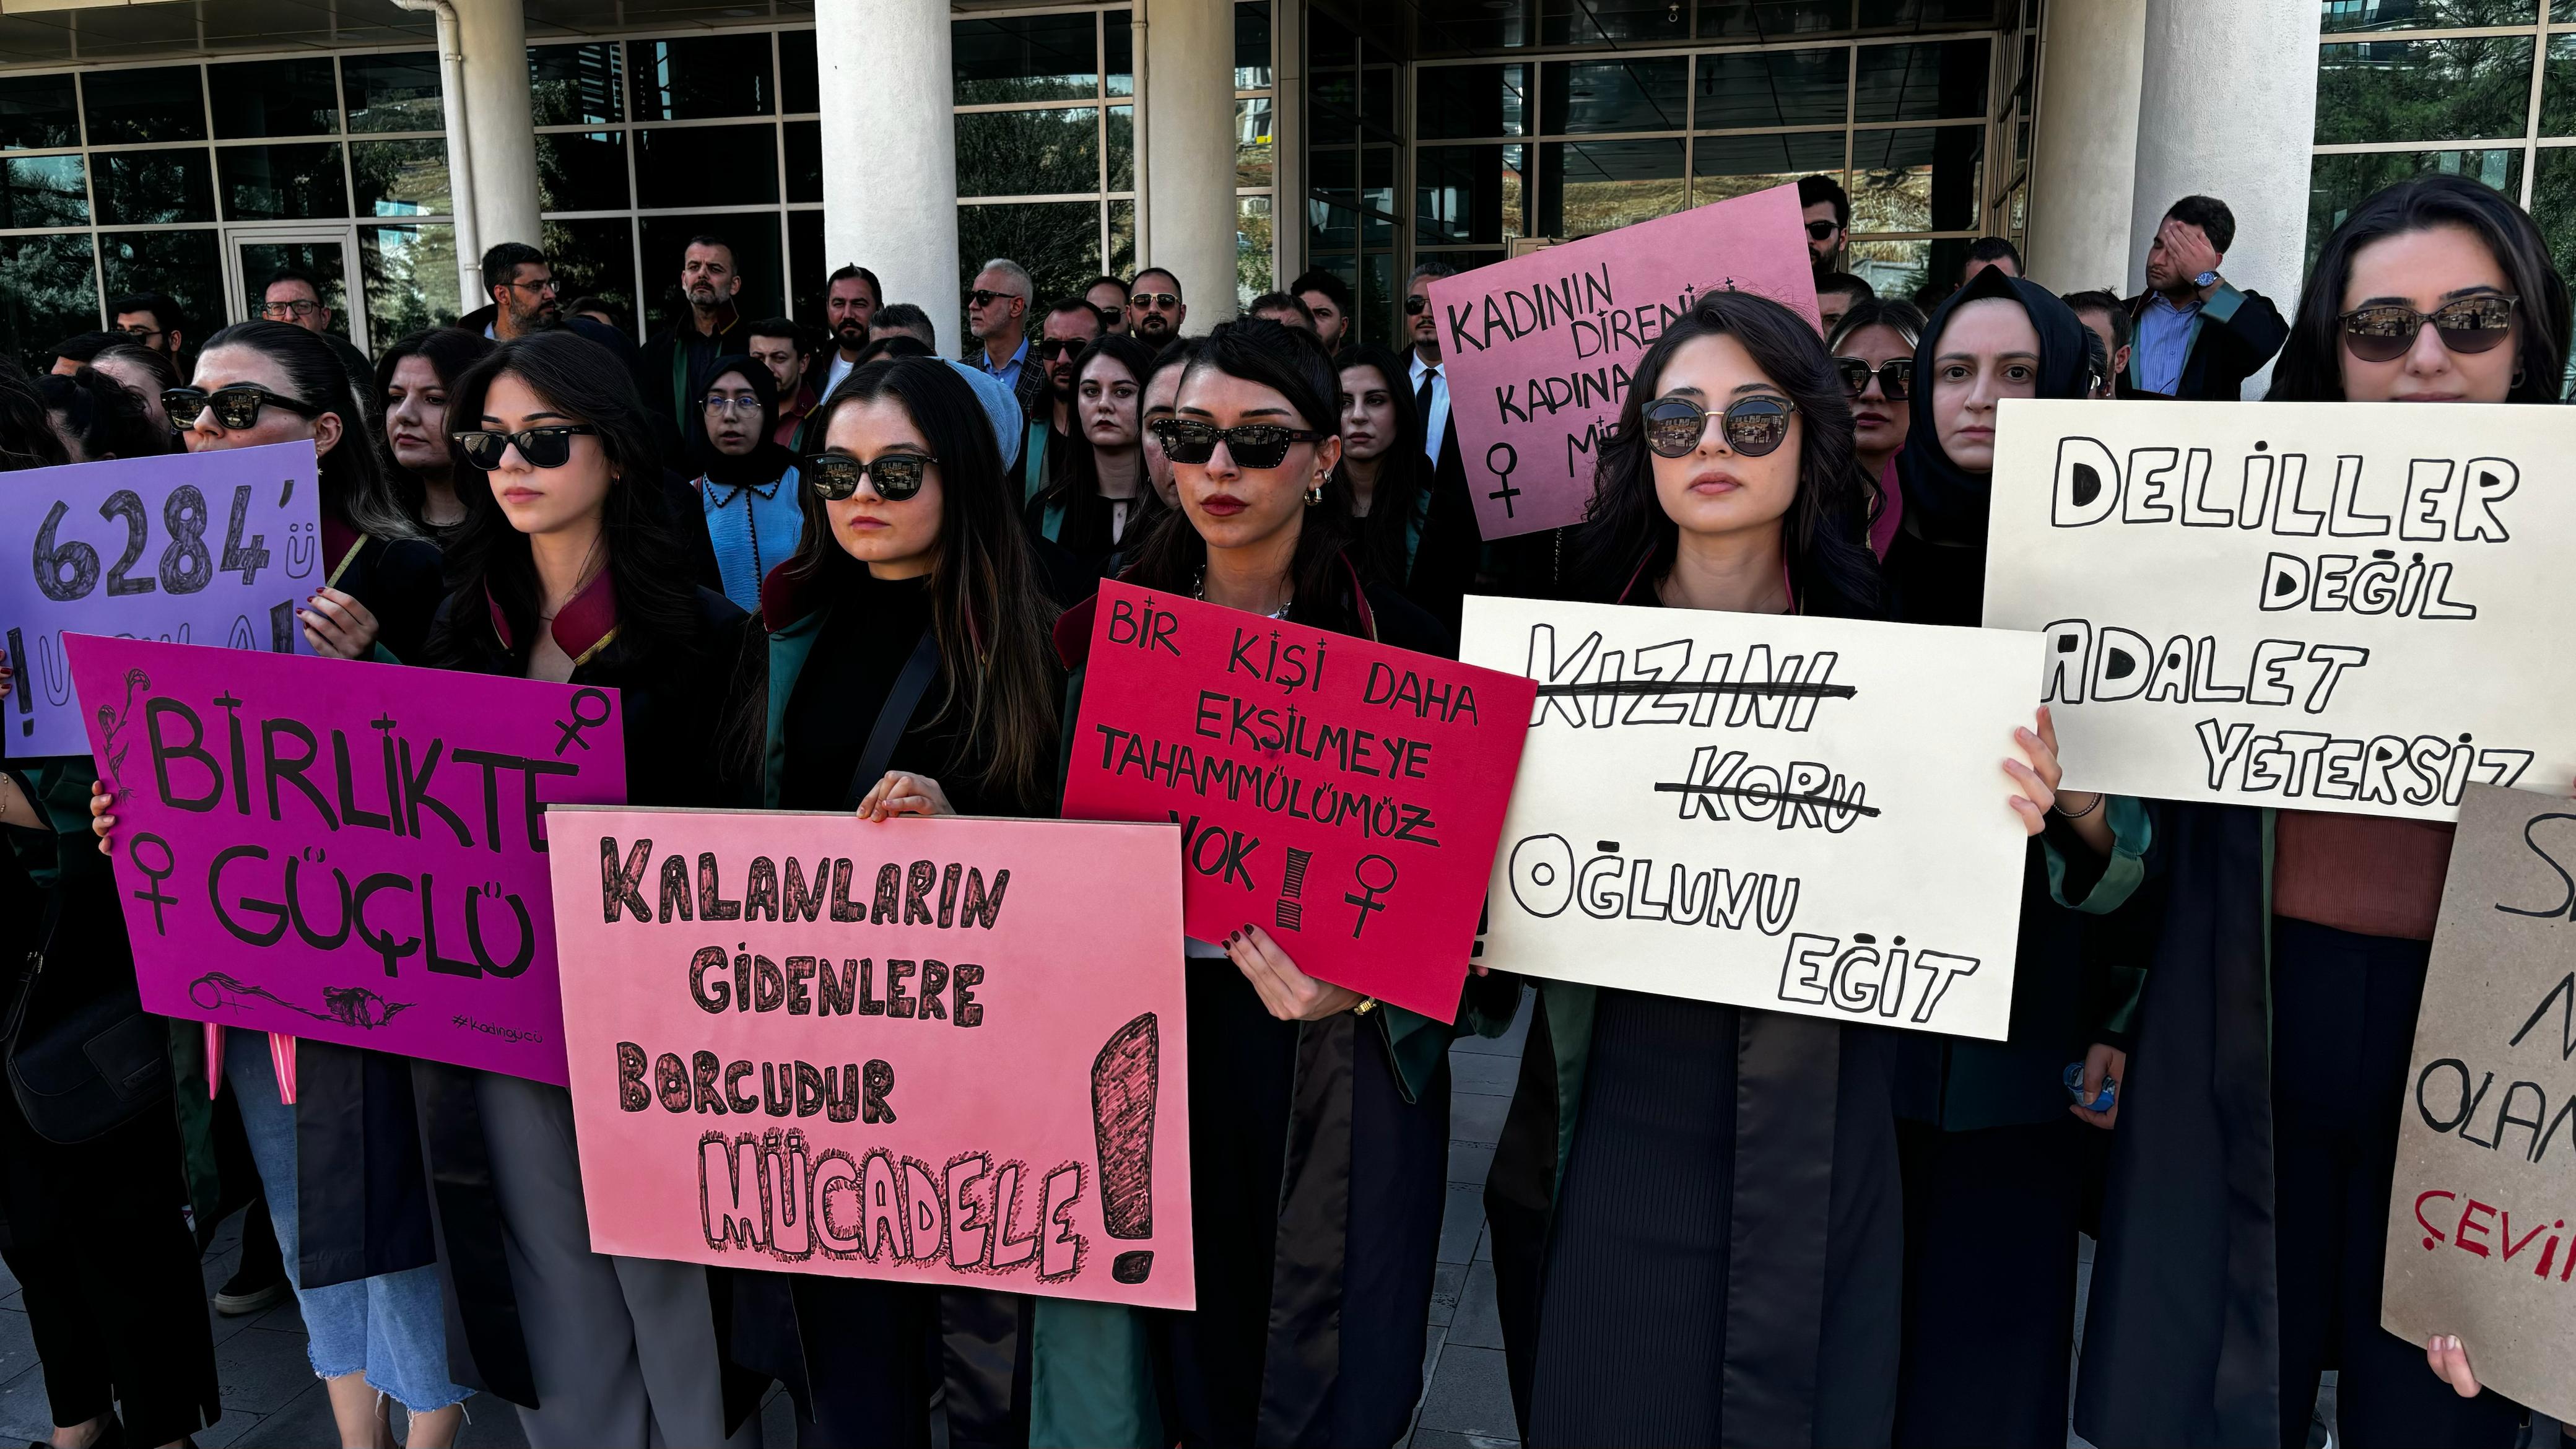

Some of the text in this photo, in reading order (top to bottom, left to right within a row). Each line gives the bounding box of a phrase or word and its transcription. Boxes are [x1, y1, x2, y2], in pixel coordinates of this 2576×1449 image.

[1447, 262, 1613, 354] KADININ
[2052, 436, 2520, 543] DELİLLER
[2260, 549, 2476, 620] DEĞİL
[1108, 596, 1479, 726] BİR KİŞİ DAHA
[1526, 623, 1839, 732] KIZINI
[2040, 619, 2369, 714] ADALET
[146, 689, 581, 853] BİRLİKTE
[1096, 723, 1440, 846] TAHAMMÜLÜMÜZ
[1680, 745, 1865, 833] KORU
[2195, 718, 2535, 806] YETERSİZ
[209, 844, 535, 978] GÜÇLÜ
[600, 836, 1010, 930] KALANLARIN
[1509, 833, 1799, 936] OĞLUNU
[689, 942, 985, 1029] GİDENLERE
[1778, 933, 1980, 1023] EĞİT
[617, 1041, 897, 1125] BORCUDUR
[2414, 1190, 2576, 1282] ÇEVİ
